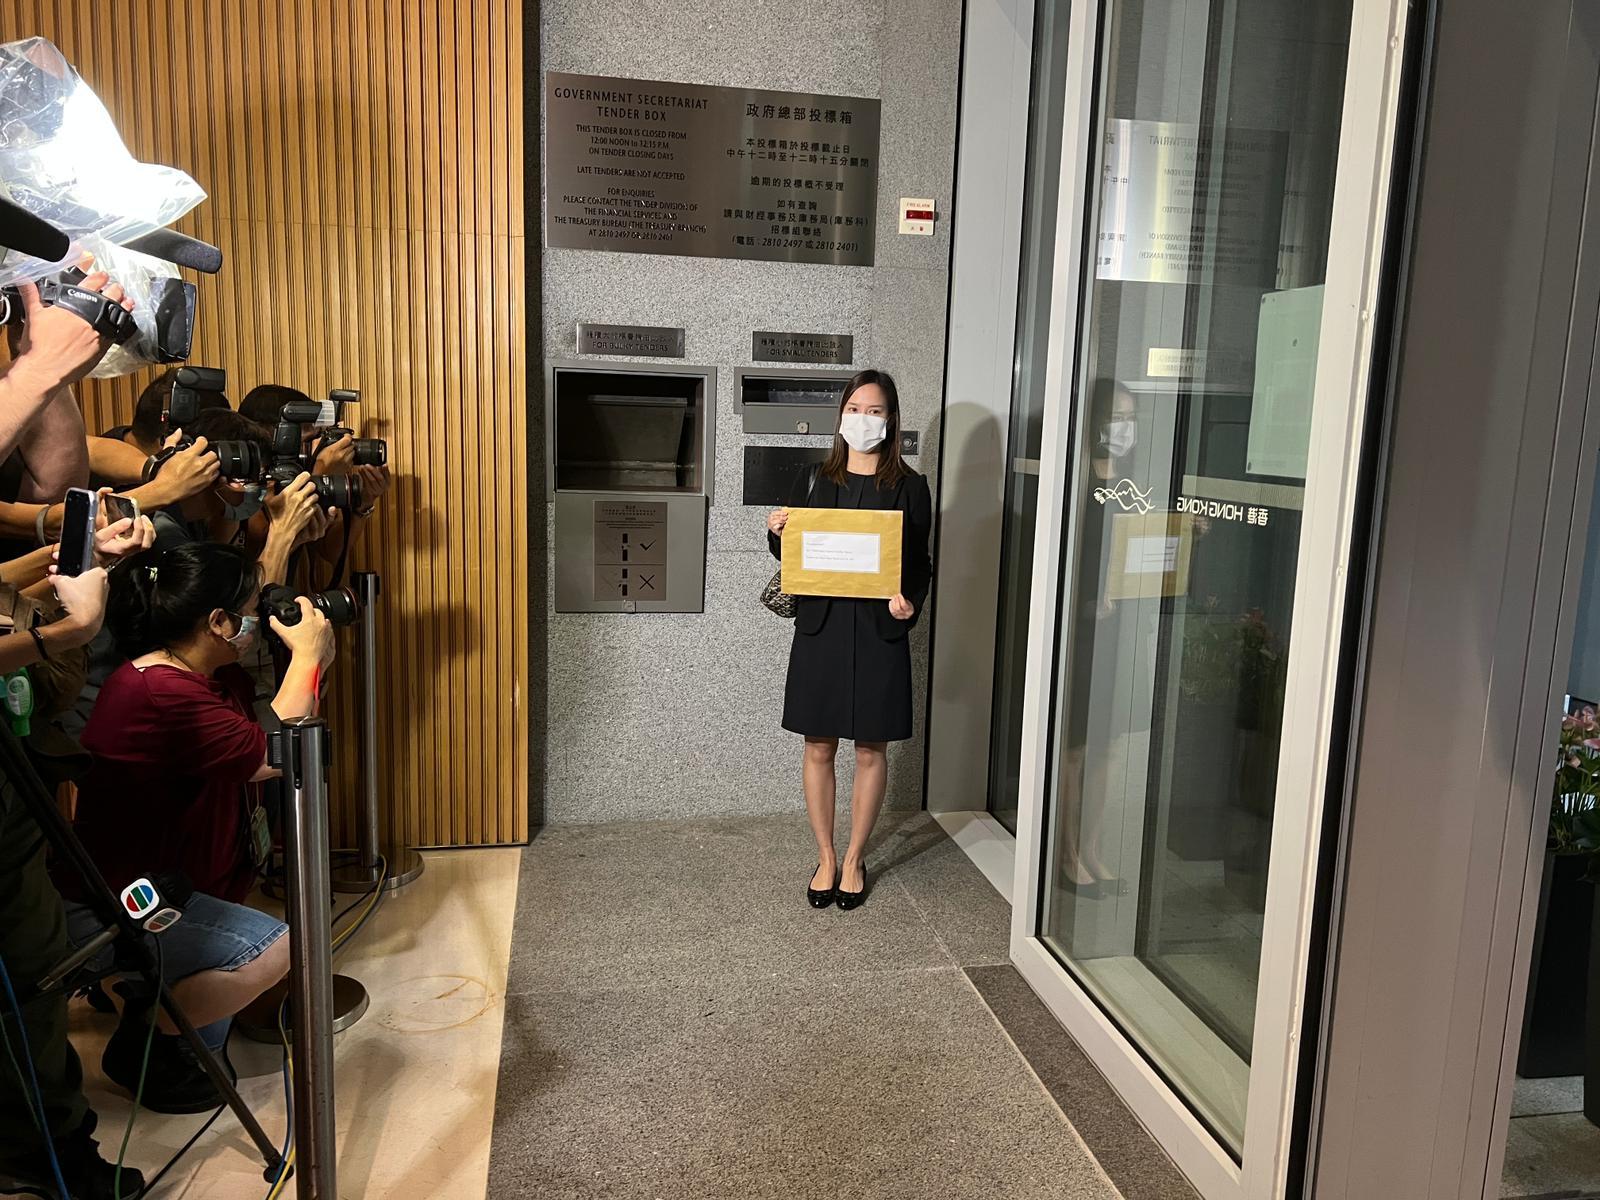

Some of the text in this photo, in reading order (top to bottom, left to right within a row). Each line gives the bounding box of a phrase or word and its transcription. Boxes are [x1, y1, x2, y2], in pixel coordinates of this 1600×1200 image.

[554, 87, 708, 110] GOVERNMENT SECRETARIAT
[597, 106, 667, 121] TENDER BOX
[746, 104, 853, 124] 政府總部投標箱
[576, 124, 686, 140] THIS TENDER BOX IS CLOSED FROM
[591, 136, 608, 145] 12:00
[609, 138, 629, 146] NOON
[602, 148, 626, 157] TENDER
[628, 150, 656, 159] CLOSING
[577, 166, 685, 180] LATE TENDERS ARE NOT ACCEPTED
[608, 188, 655, 197] FOR ENQUIRIES
[564, 195, 586, 204] PLEASE
[588, 197, 618, 206] CONTACT
[620, 198, 632, 207] THE
[634, 200, 658, 208] TENDER
[660, 202, 688, 211] DIVISION
[585, 207, 677, 220] THE FINANCIAL SERVICES AND
[555, 216, 567, 224] THE
[568, 217, 600, 226] TREASURY
[602, 219, 626, 228] BUREAU
[762, 238, 781, 247] 2810
[783, 239, 802, 248] 2497
[816, 242, 835, 250] 2810
[67, 288, 98, 303] Canon
[592, 341, 607, 349] FOR
[636, 343, 668, 352] TENDERS
